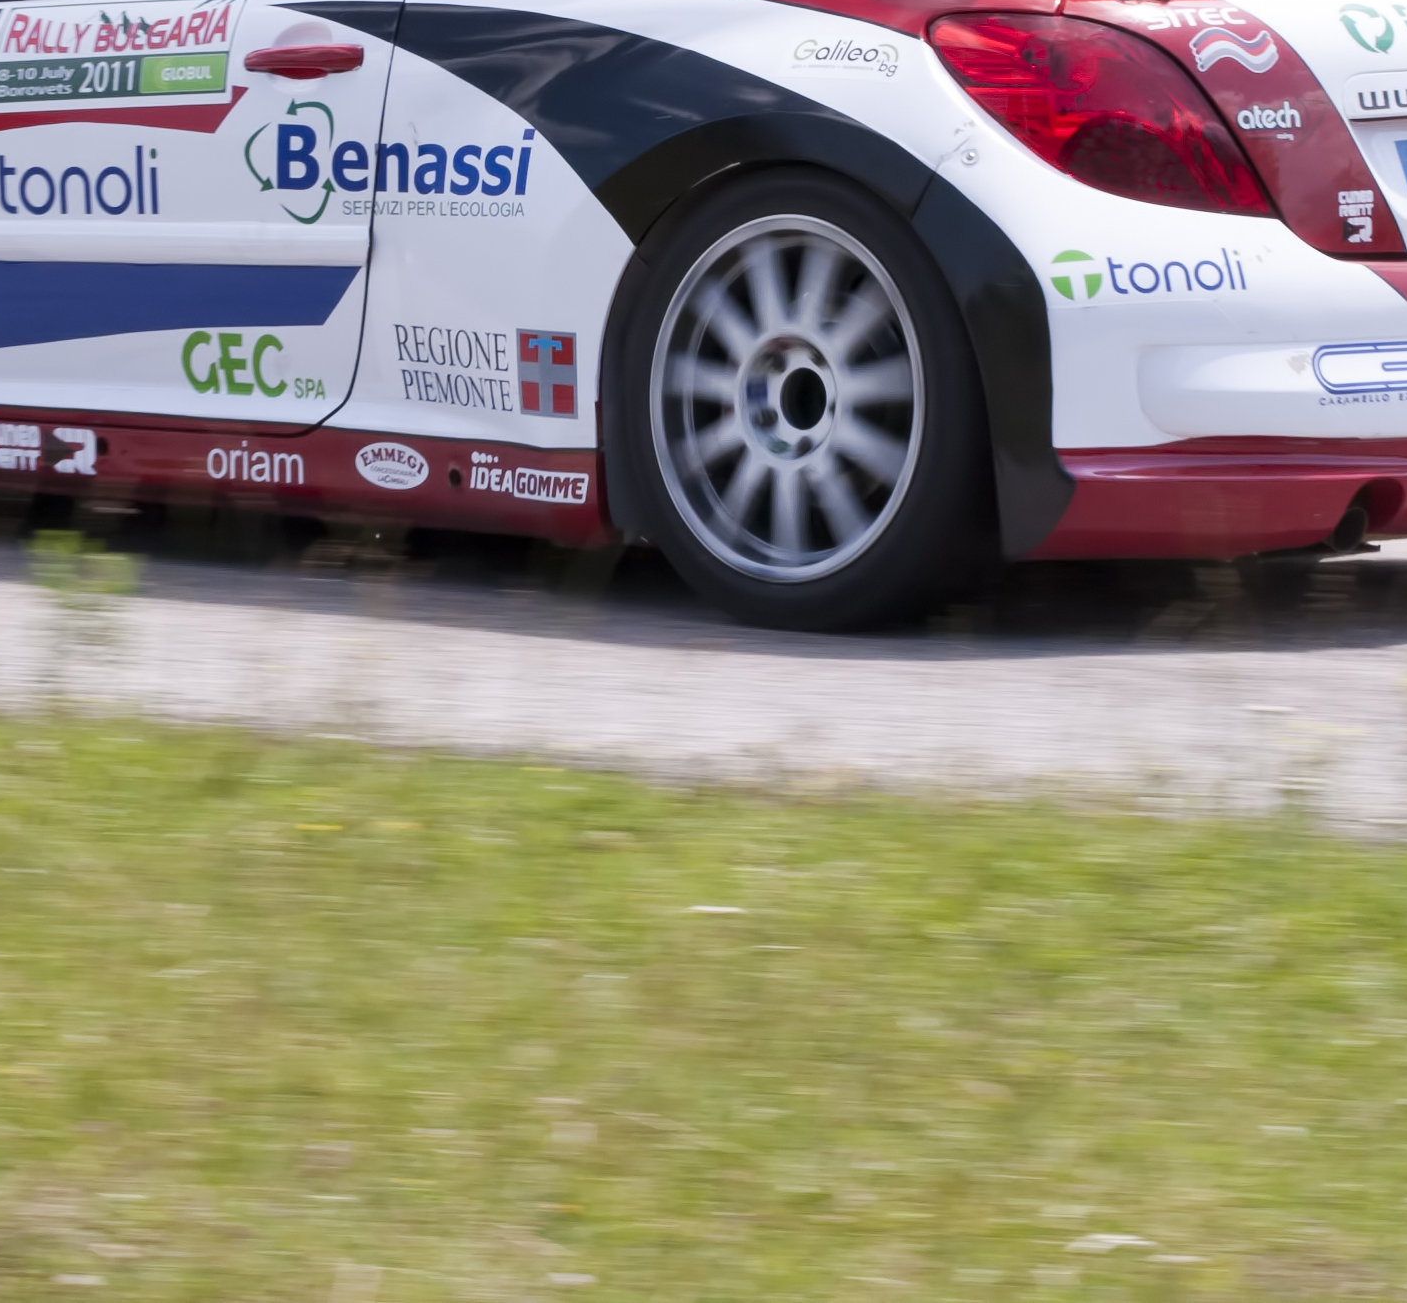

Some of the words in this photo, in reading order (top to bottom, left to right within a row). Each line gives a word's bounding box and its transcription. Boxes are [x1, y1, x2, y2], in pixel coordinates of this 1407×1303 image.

[4, 13, 91, 54] RALLY
[40, 65, 75, 81] July
[79, 61, 136, 94] 2011
[277, 124, 536, 196] Benassi
[407, 201, 436, 216] PER
[440, 201, 525, 218] L'ECOLOGIA
[1107, 247, 1247, 295] tonoli
[394, 324, 510, 372] REGIONE
[294, 378, 326, 400] SPA
[402, 368, 514, 413] PIEMONTE
[1319, 393, 1390, 406] CARAMELLO
[207, 441, 304, 485] oriam
[360, 447, 424, 475] EMMEGI
